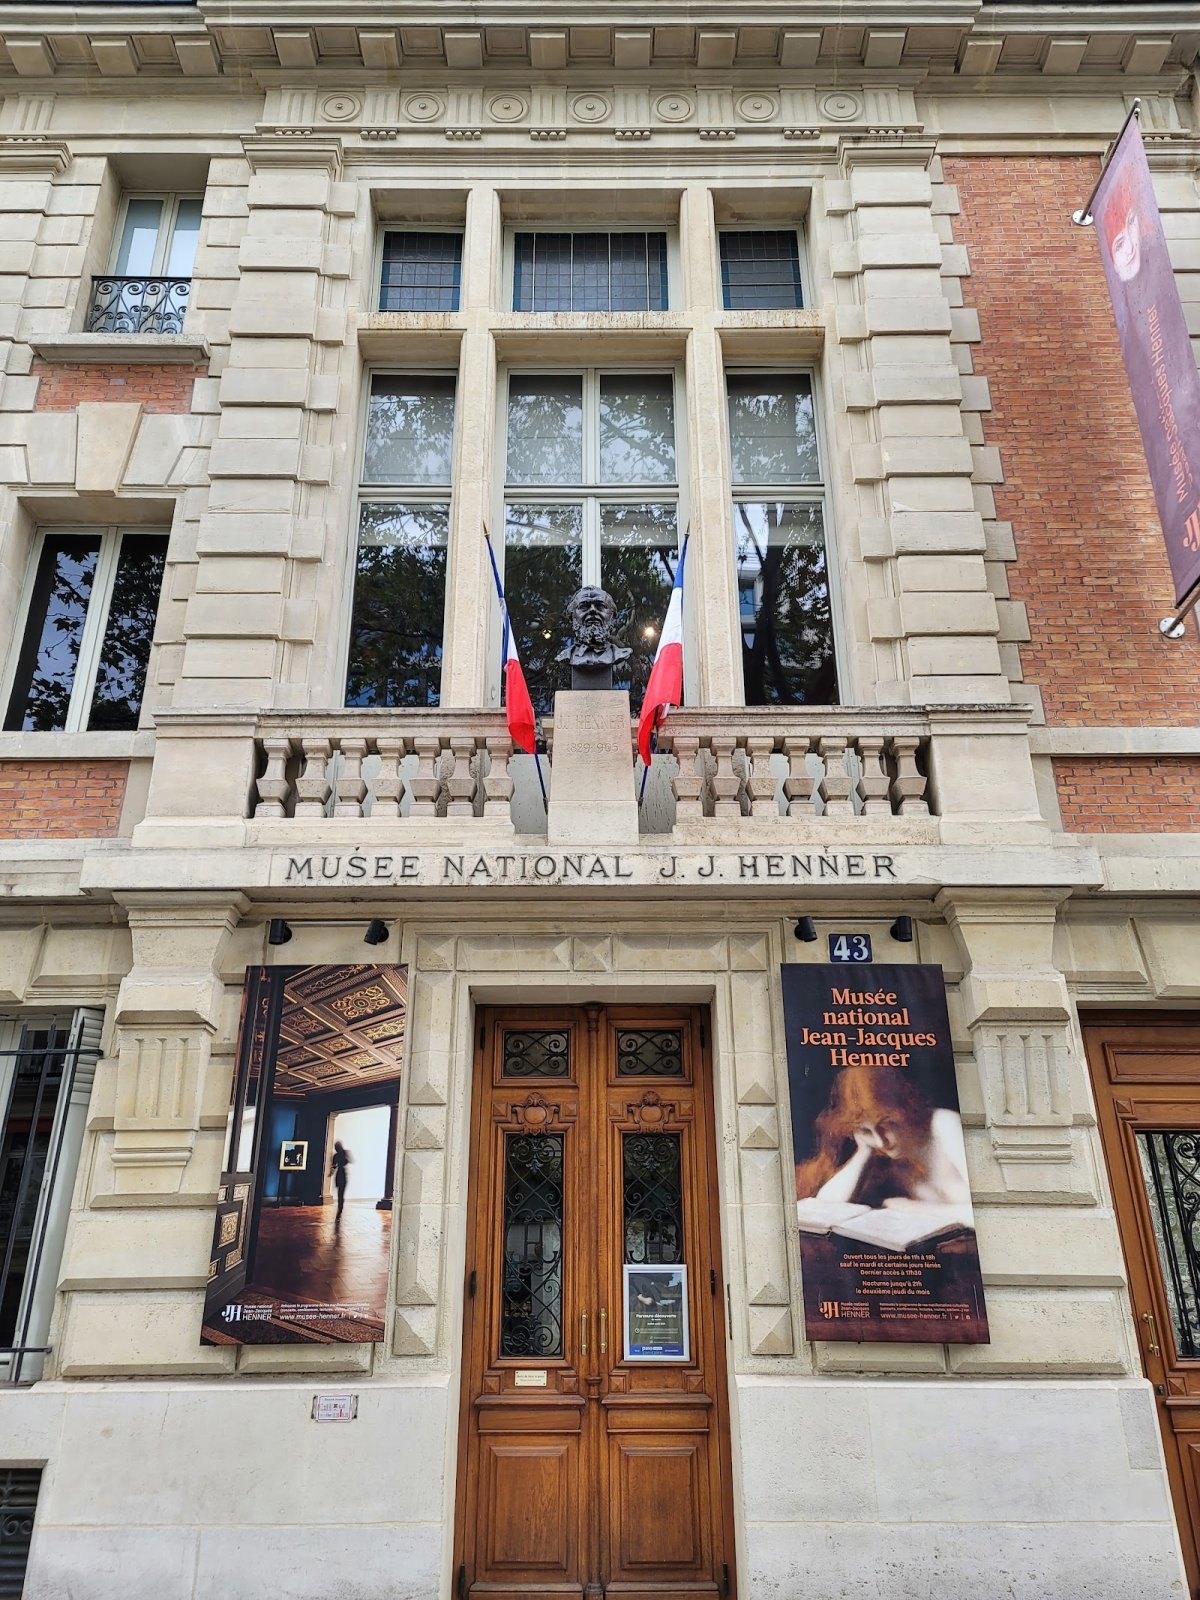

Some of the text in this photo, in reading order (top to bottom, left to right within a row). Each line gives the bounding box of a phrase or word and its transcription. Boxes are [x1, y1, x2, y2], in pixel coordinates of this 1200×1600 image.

[1146, 304, 1164, 366] Henner
[443, 855, 633, 878] NATIONAL
[739, 855, 898, 878] HENNER
[833, 935, 869, 961] 43
[831, 988, 898, 1006] Musée
[823, 1008, 911, 1026] national
[801, 1028, 937, 1050] Jean-Jacques
[830, 1049, 911, 1067] Henner
[891, 1288, 907, 1296] jeudi
[242, 1313, 272, 1321] HENNER
[280, 1312, 346, 1320] www.musee-henner.fr
[841, 1310, 871, 1318] HENNER
